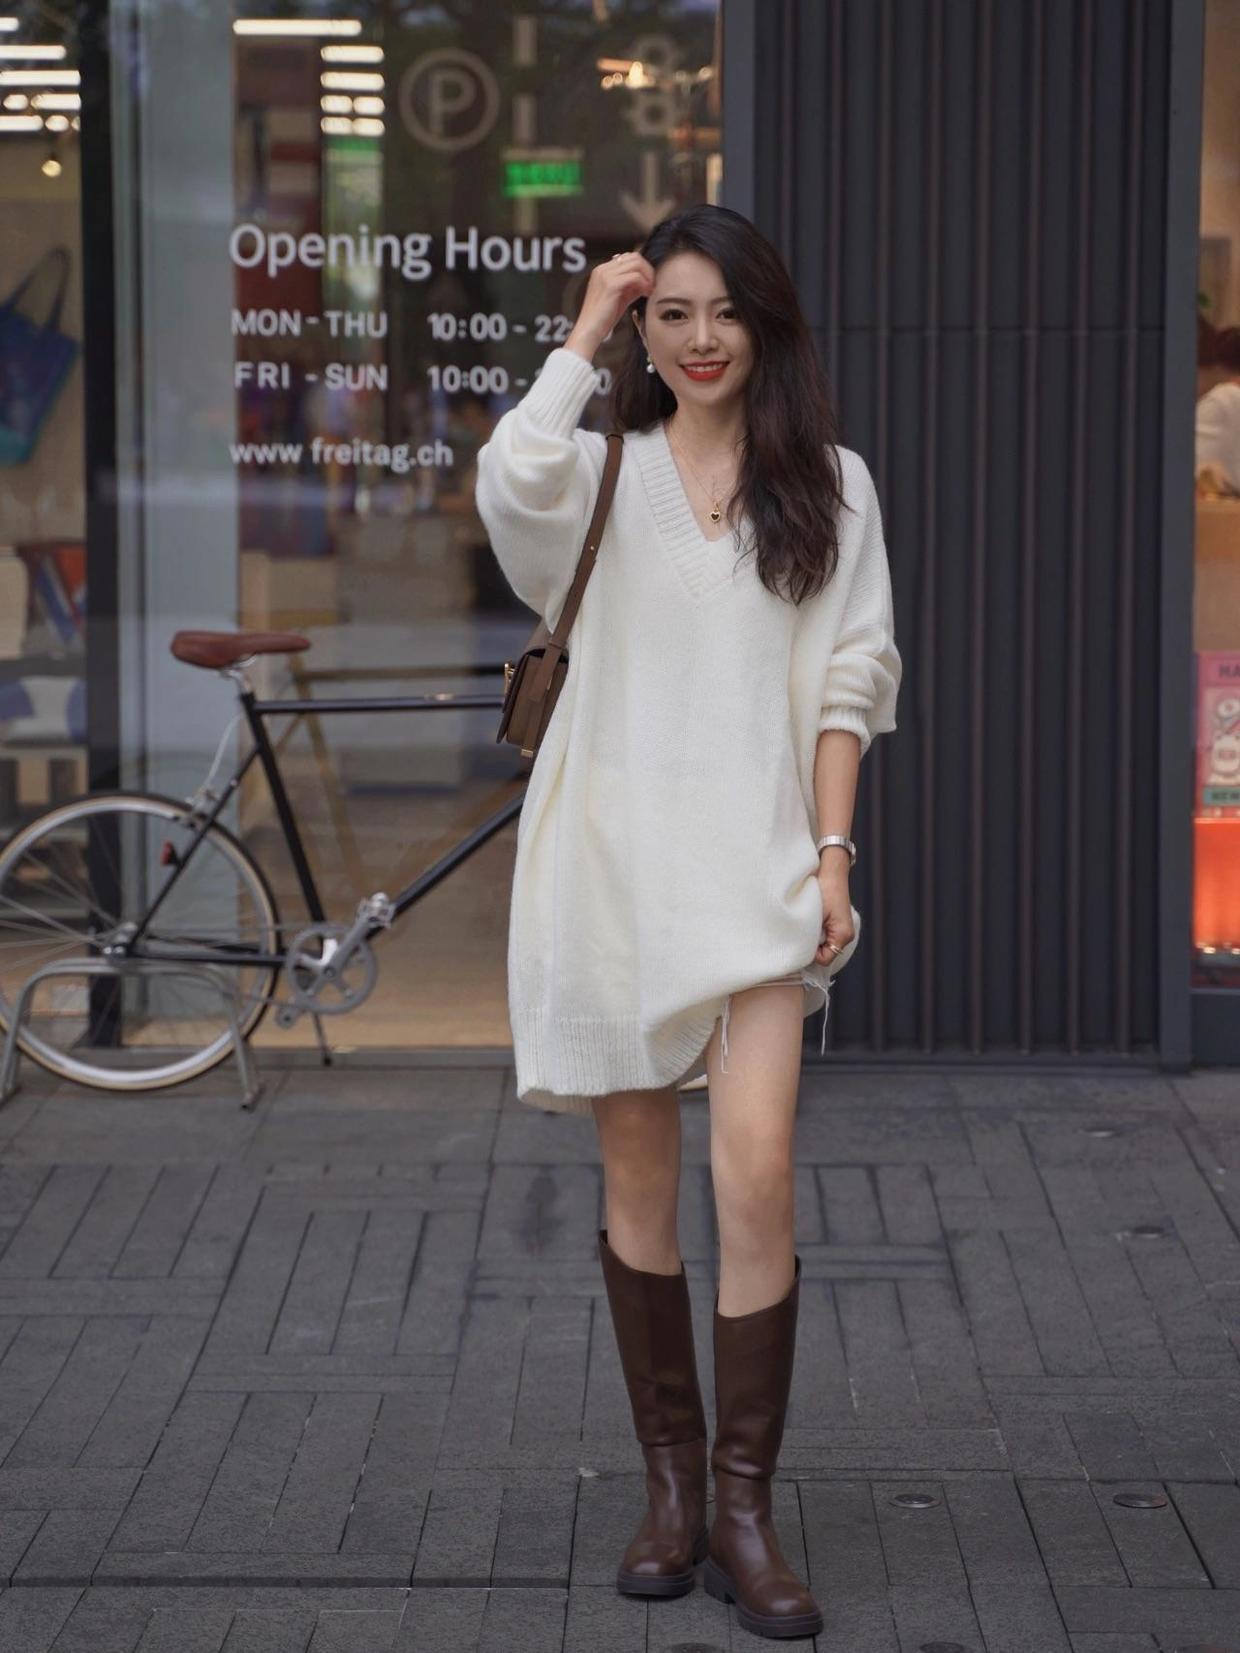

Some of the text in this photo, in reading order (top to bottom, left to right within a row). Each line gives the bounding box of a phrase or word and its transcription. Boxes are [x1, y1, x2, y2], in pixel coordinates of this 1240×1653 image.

[229, 223, 587, 281] Opening Hours
[231, 308, 302, 337] MON
[324, 310, 388, 339] THU
[428, 313, 507, 342] 10:00
[234, 361, 291, 390] FRI
[324, 362, 388, 392] SUN
[428, 366, 509, 394] 10:00
